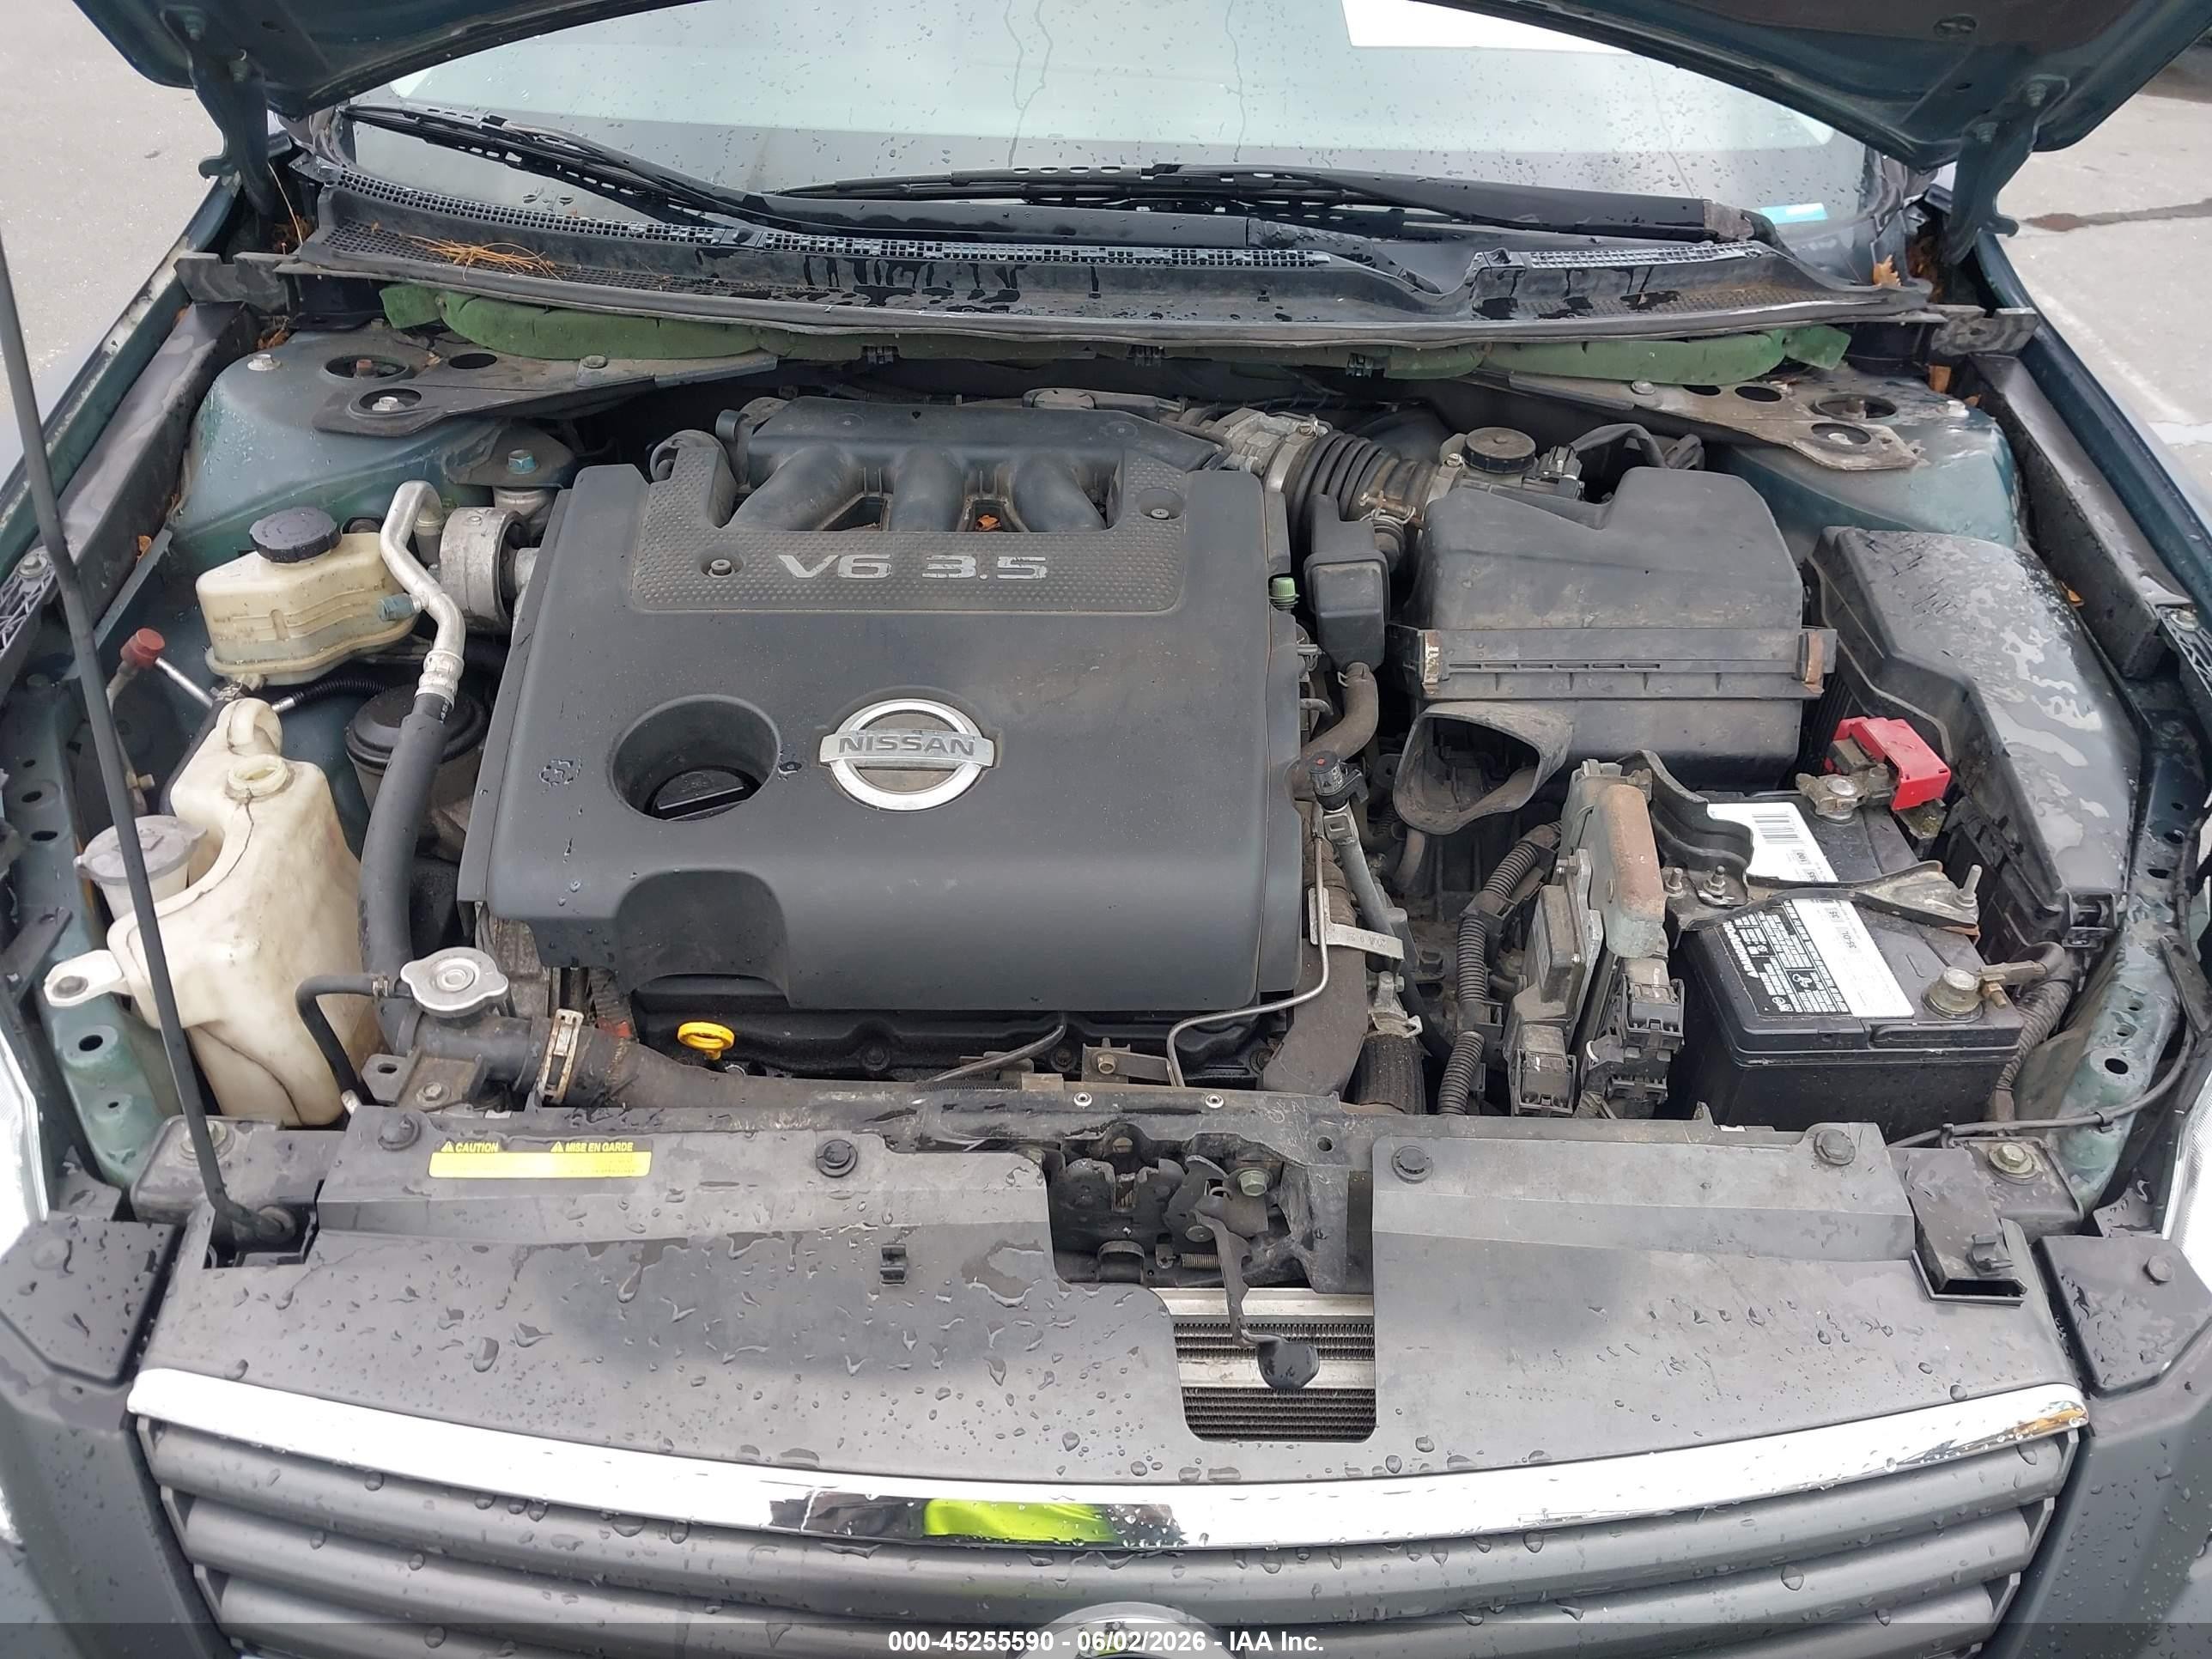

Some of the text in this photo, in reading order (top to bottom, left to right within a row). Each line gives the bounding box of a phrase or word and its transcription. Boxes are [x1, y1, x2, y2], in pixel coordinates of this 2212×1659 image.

[778, 554, 1048, 580] V6 3.5
[838, 735, 975, 757] NISSAN
[455, 1142, 500, 1152] CAUTION
[565, 1142, 634, 1152] MISE EN GARDE
